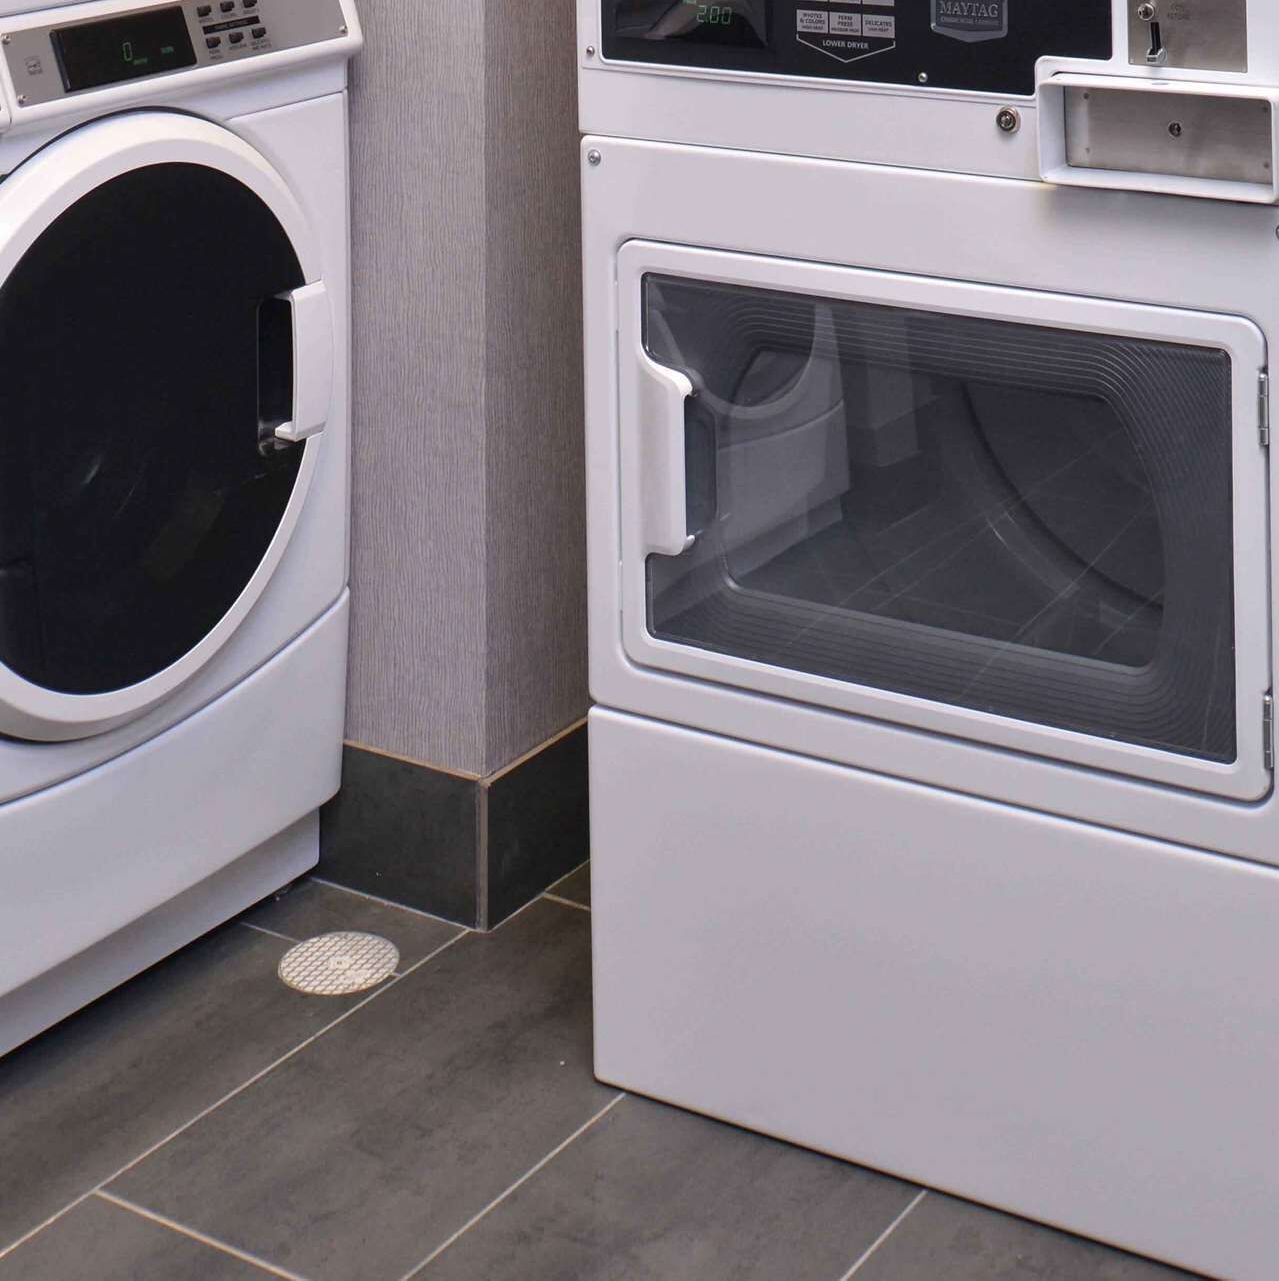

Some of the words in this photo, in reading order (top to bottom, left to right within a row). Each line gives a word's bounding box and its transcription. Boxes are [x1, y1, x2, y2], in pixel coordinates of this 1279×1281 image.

[939, 0, 999, 18] MAYTAG
[822, 39, 846, 48] LOWER
[847, 41, 870, 50] DRYER
